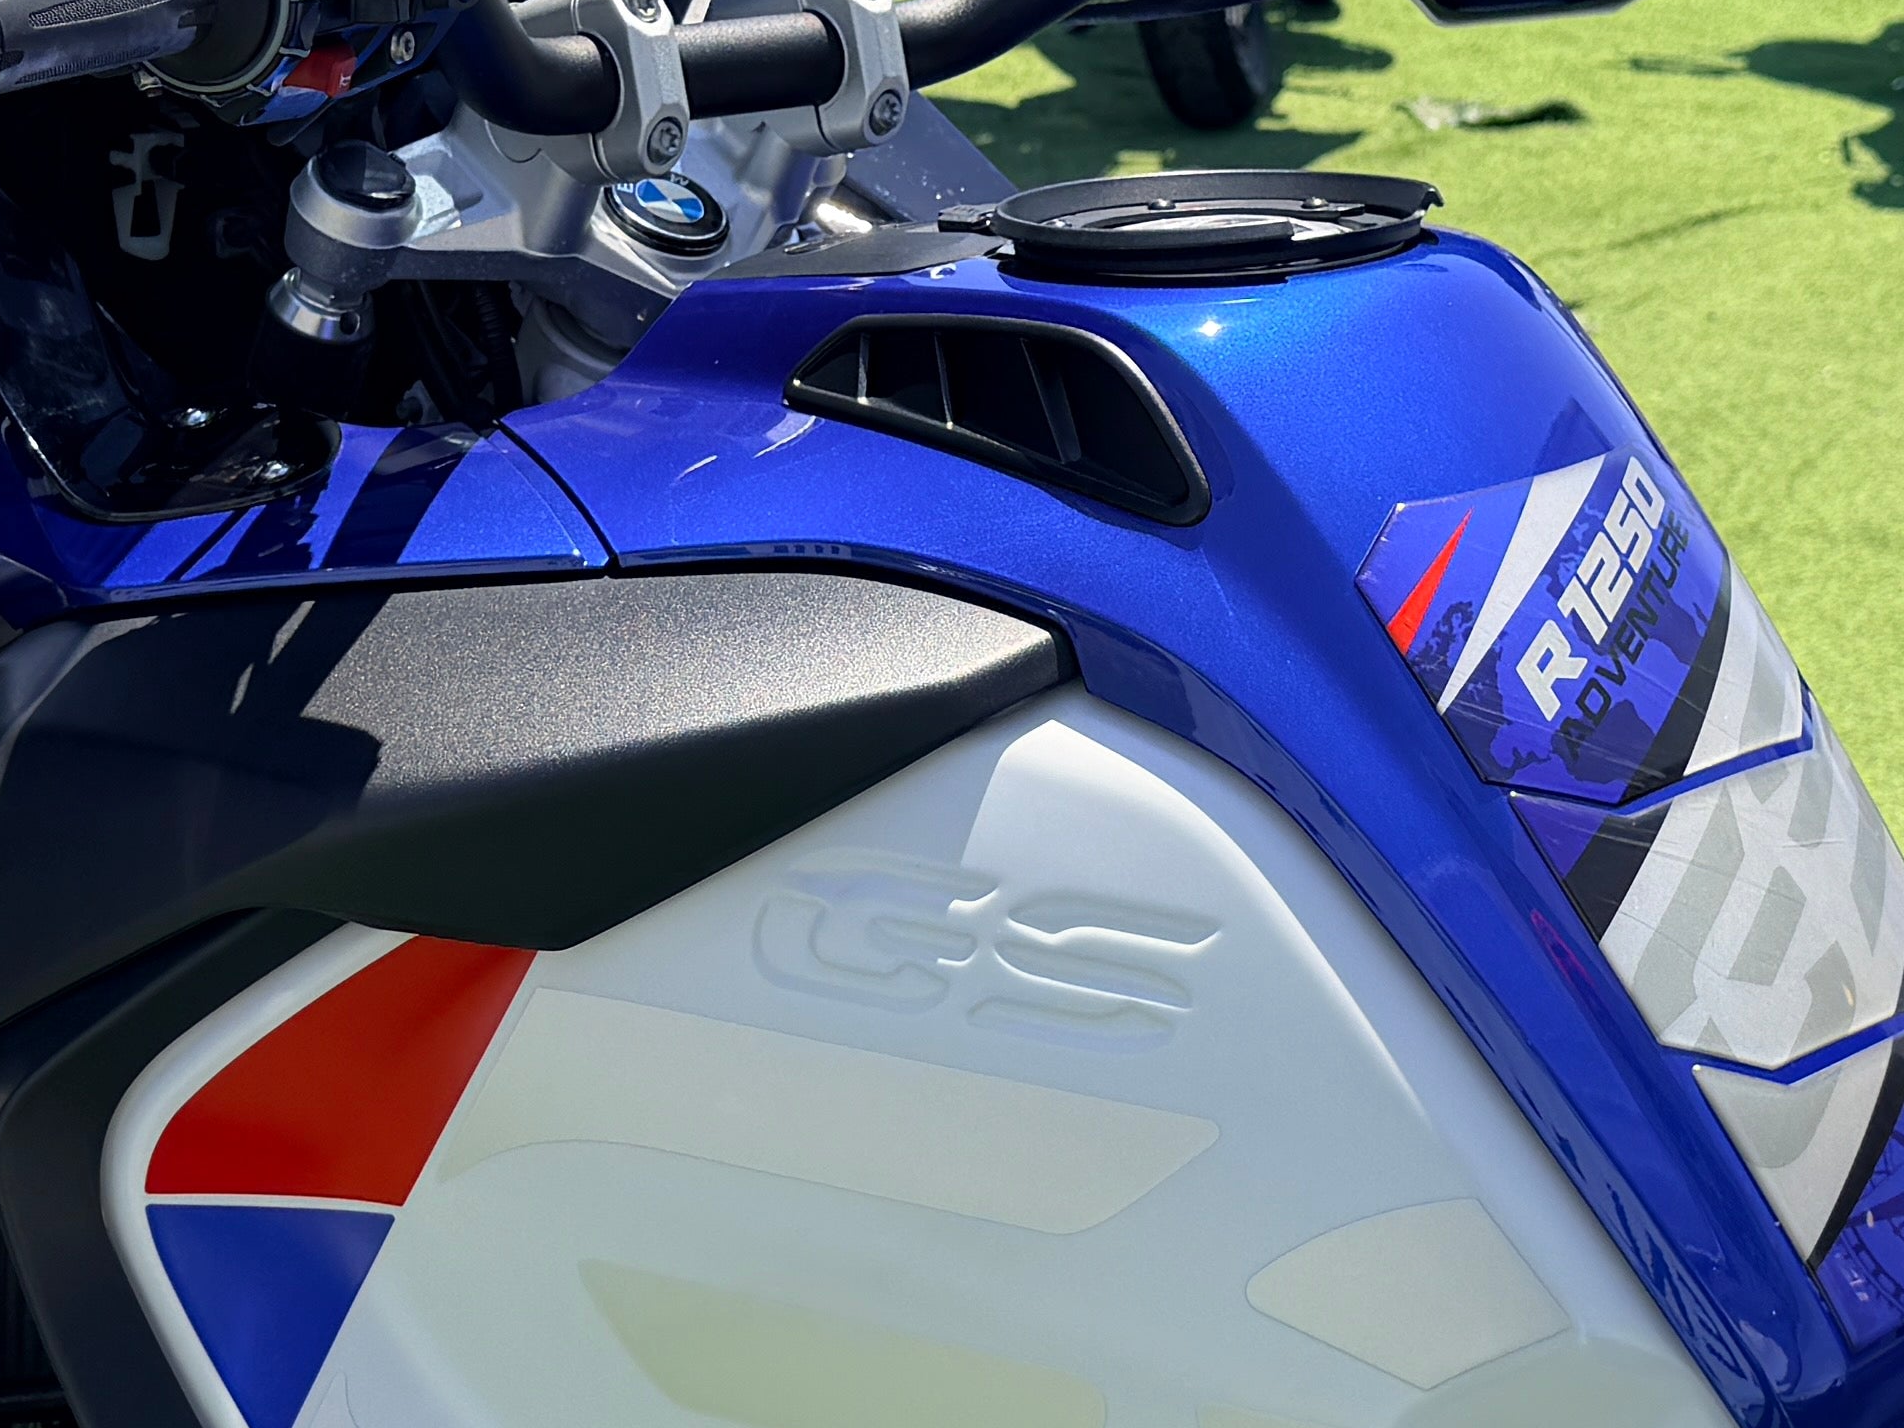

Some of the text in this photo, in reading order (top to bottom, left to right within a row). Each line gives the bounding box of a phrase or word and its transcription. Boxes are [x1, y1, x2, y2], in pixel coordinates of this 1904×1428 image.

[1516, 456, 1666, 721] R 1250
[1559, 510, 1689, 763] ADVENTURE
[751, 846, 1222, 1055] GS
